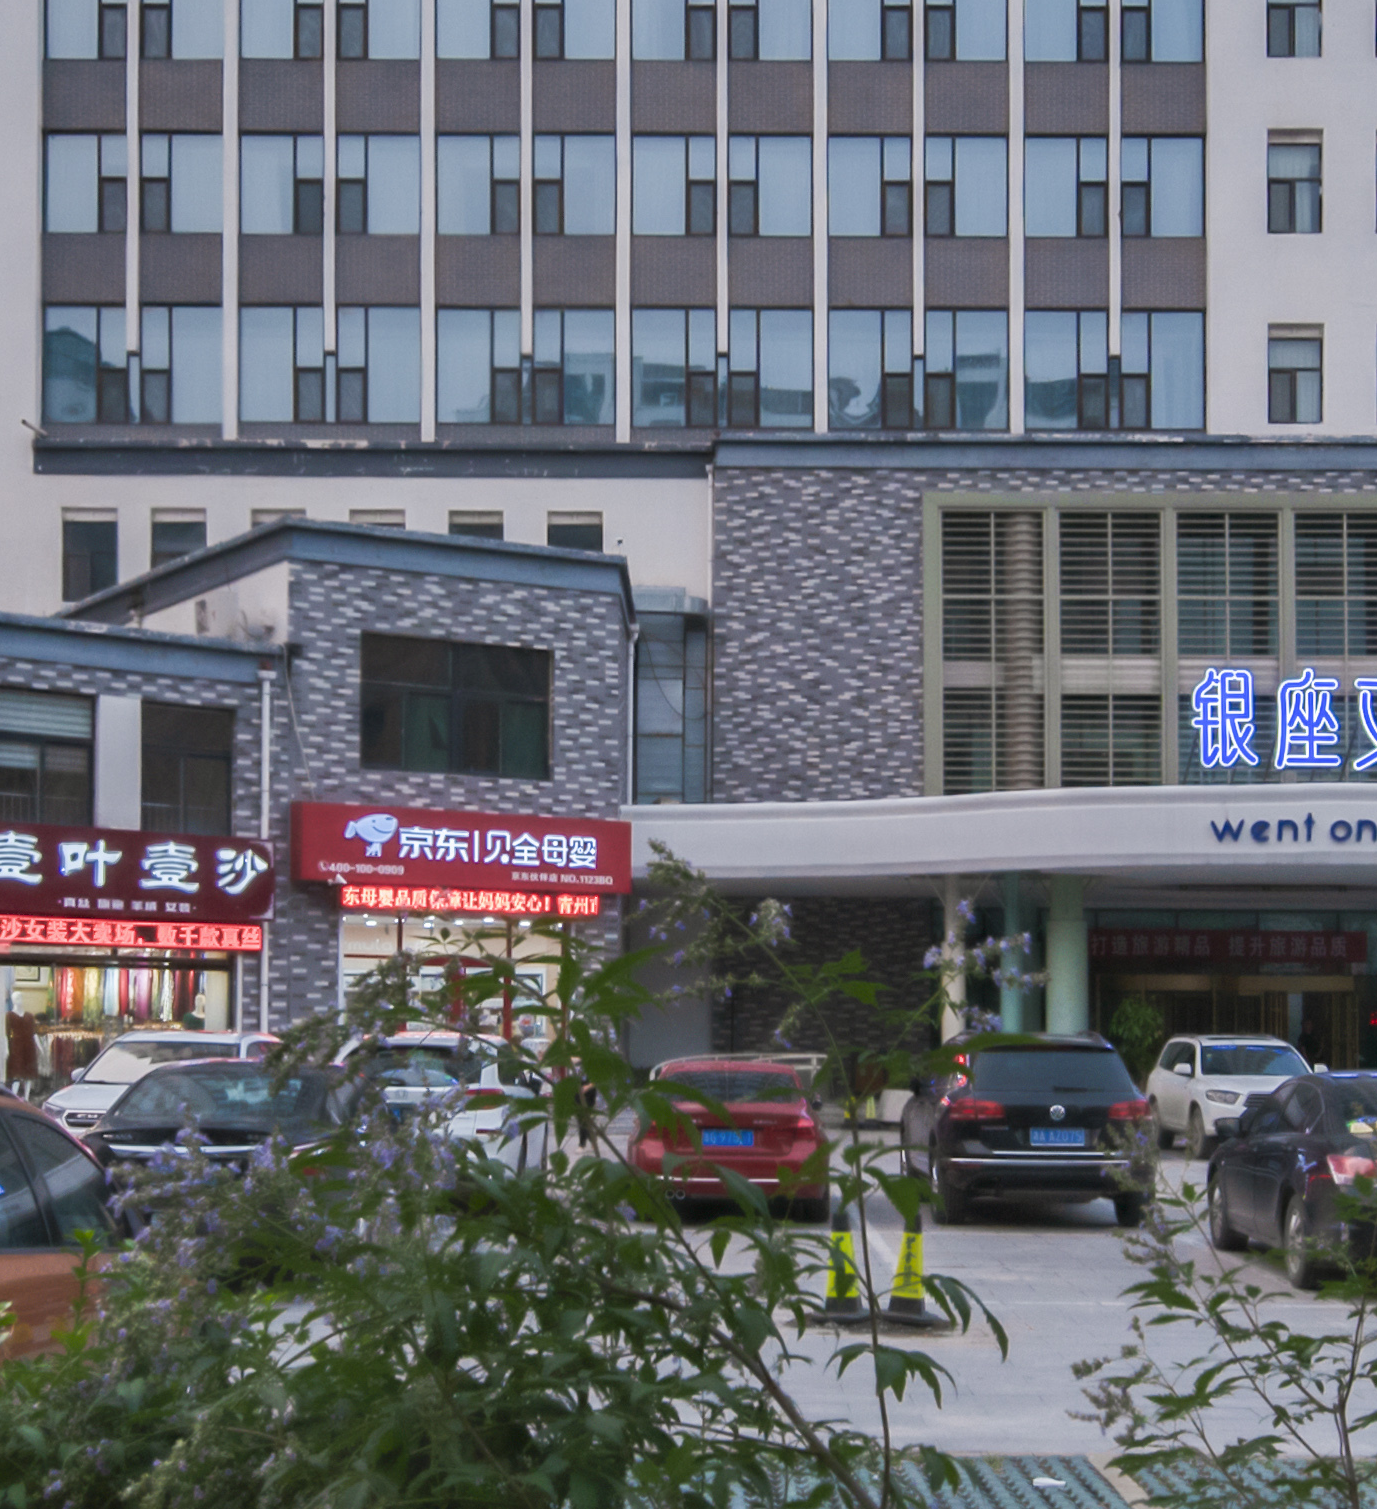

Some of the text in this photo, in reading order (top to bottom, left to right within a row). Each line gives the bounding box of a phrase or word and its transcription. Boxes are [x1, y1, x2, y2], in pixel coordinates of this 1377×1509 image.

[1210, 812, 1315, 843] went
[1228, 935, 1348, 959] 提升旅游品质
